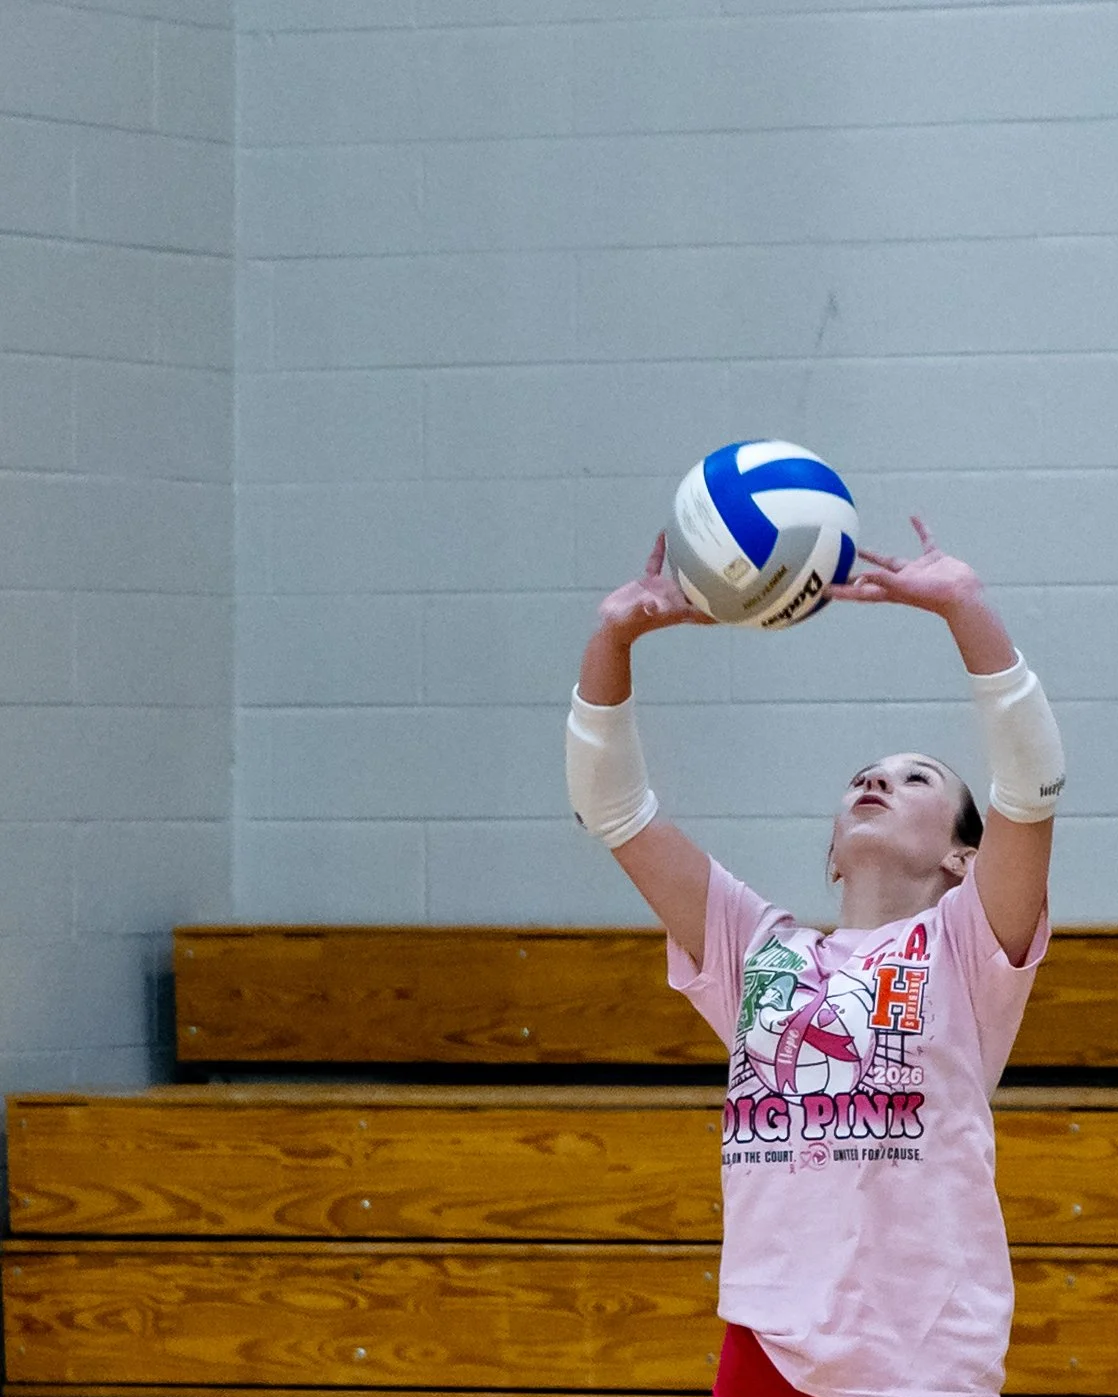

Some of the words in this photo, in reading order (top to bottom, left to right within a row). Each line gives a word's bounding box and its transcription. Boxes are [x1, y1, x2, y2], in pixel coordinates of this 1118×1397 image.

[869, 966, 928, 1033] H
[904, 971, 921, 1028] FIREBIRDS
[777, 1028, 800, 1065] Hope
[873, 1065, 924, 1086] 2026
[801, 1092, 925, 1140] PINK
[744, 1151, 761, 1164] THE
[764, 1150, 797, 1164] COURT.
[887, 1147, 924, 1162] CAUSE.
